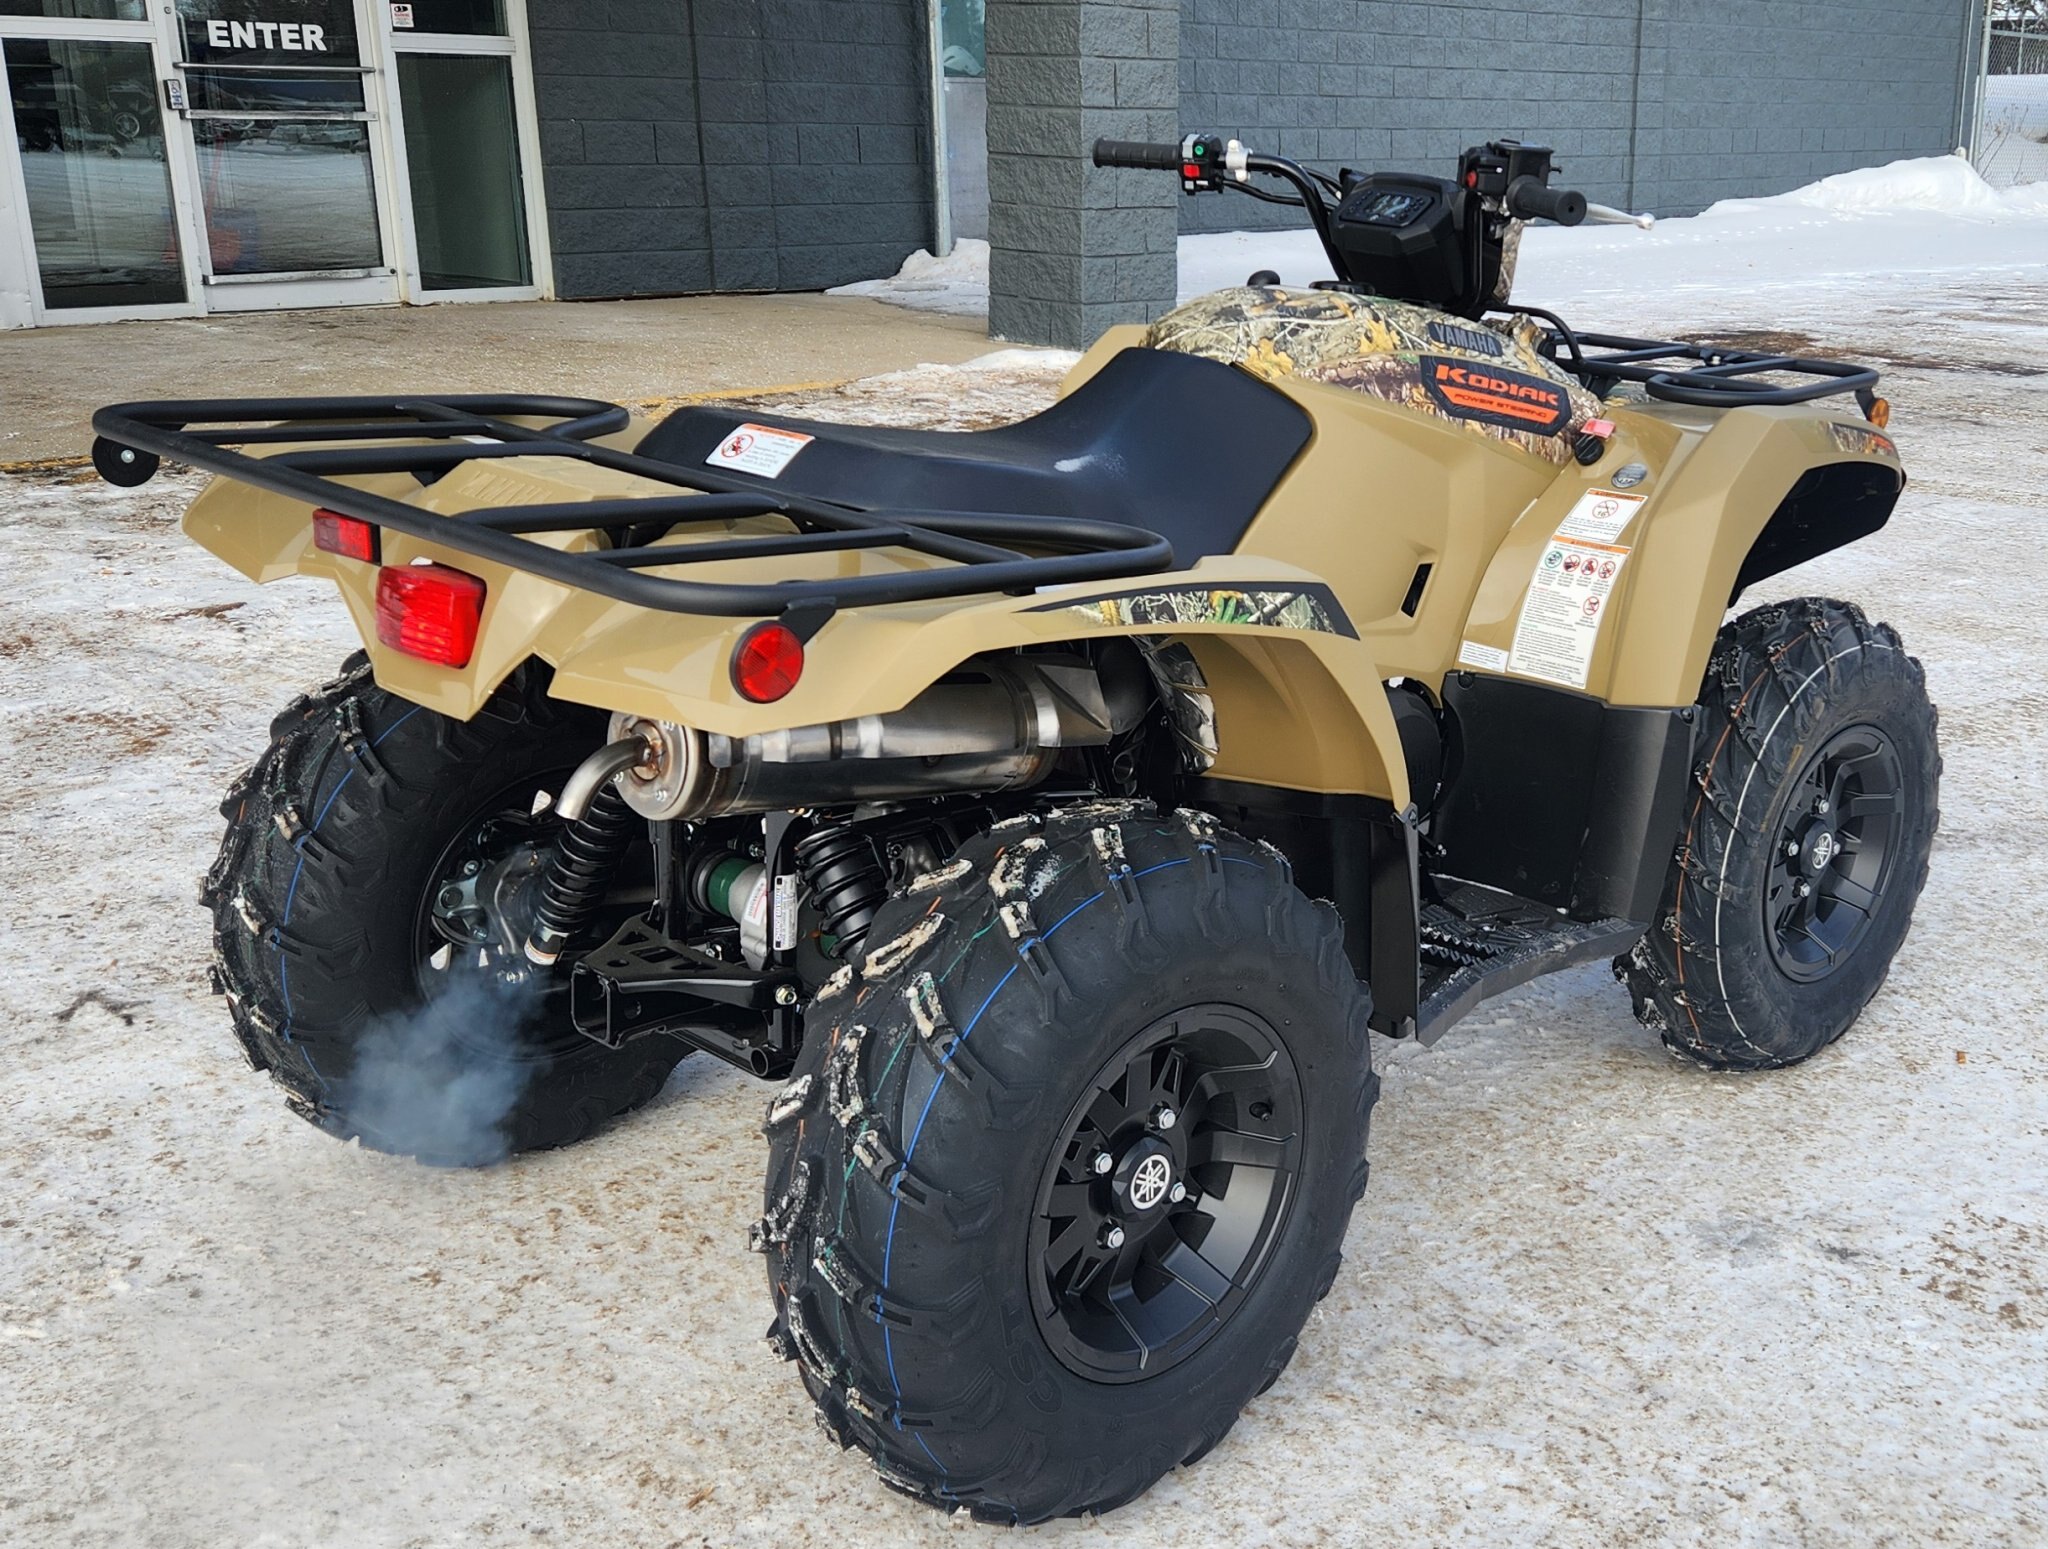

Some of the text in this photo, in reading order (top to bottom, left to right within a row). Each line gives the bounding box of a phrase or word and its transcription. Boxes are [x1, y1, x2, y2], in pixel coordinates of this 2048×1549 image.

[206, 20, 327, 51] ENTER
[1434, 322, 1498, 356] YAMAHA
[1436, 364, 1559, 406] KODIAK
[1454, 393, 1547, 418] POWER STEERING
[999, 1303, 1064, 1415] CST
